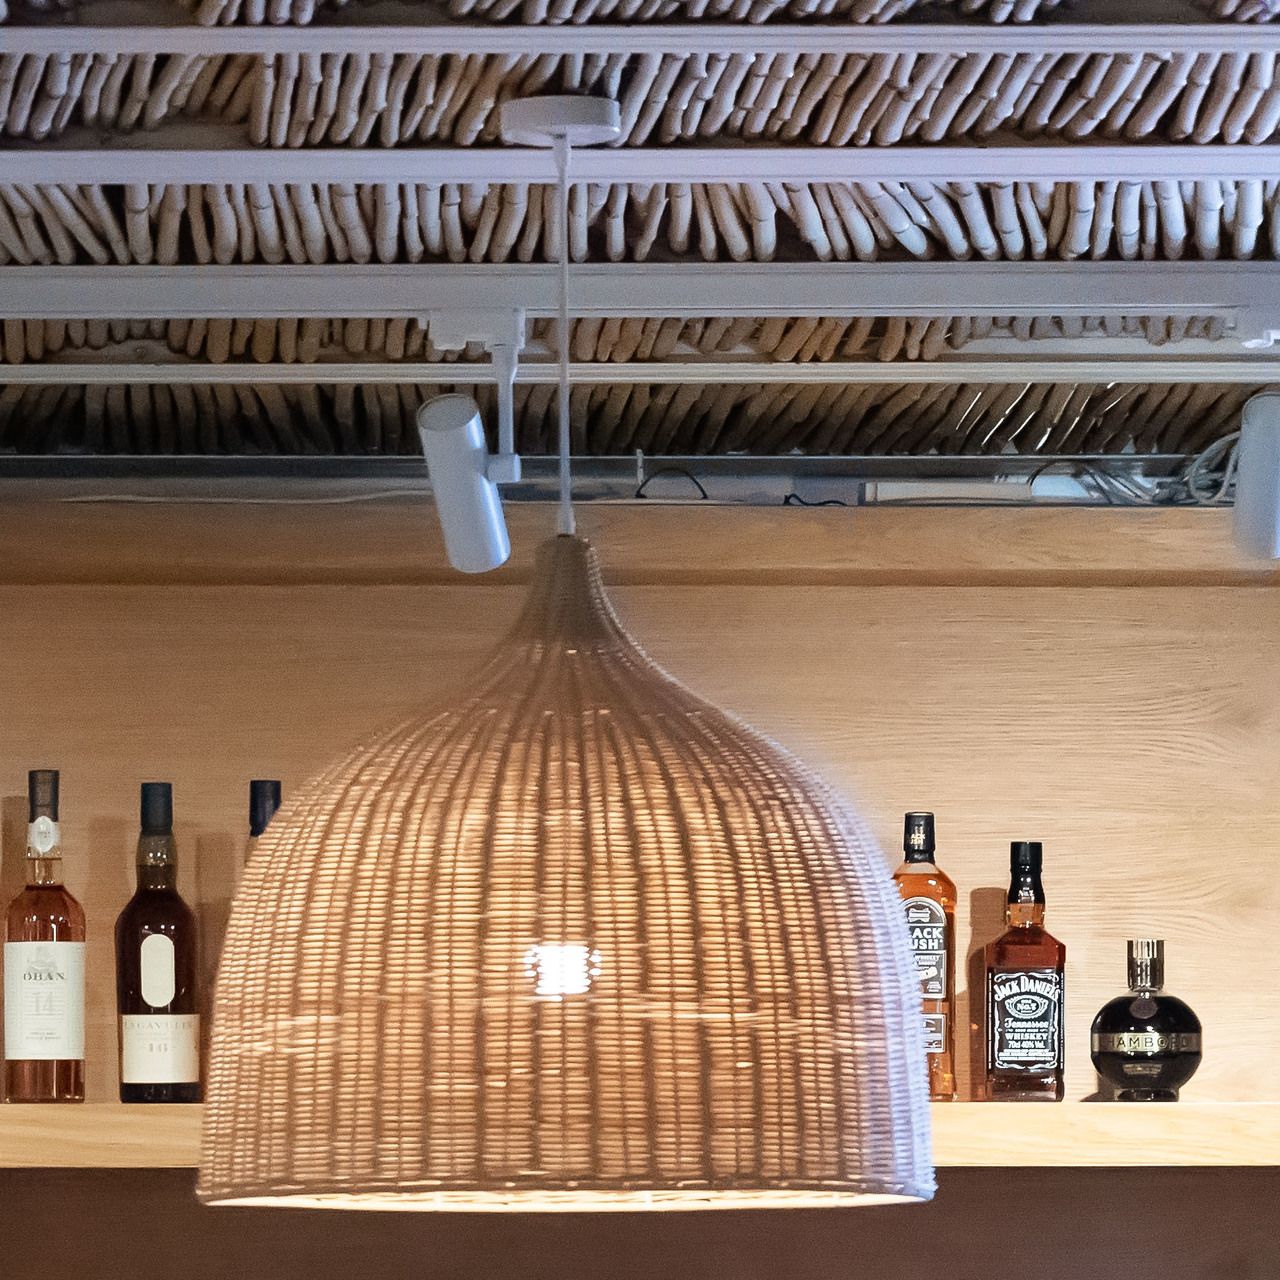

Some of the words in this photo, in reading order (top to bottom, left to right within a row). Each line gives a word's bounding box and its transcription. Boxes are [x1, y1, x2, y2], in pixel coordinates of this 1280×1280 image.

[912, 927, 943, 938] ACK
[910, 939, 941, 950] USH
[23, 972, 65, 981] OBAN
[994, 980, 1021, 1001] JACK
[1020, 975, 1060, 1002] DANIEL'S
[1004, 1032, 1049, 1040] WHISKEY
